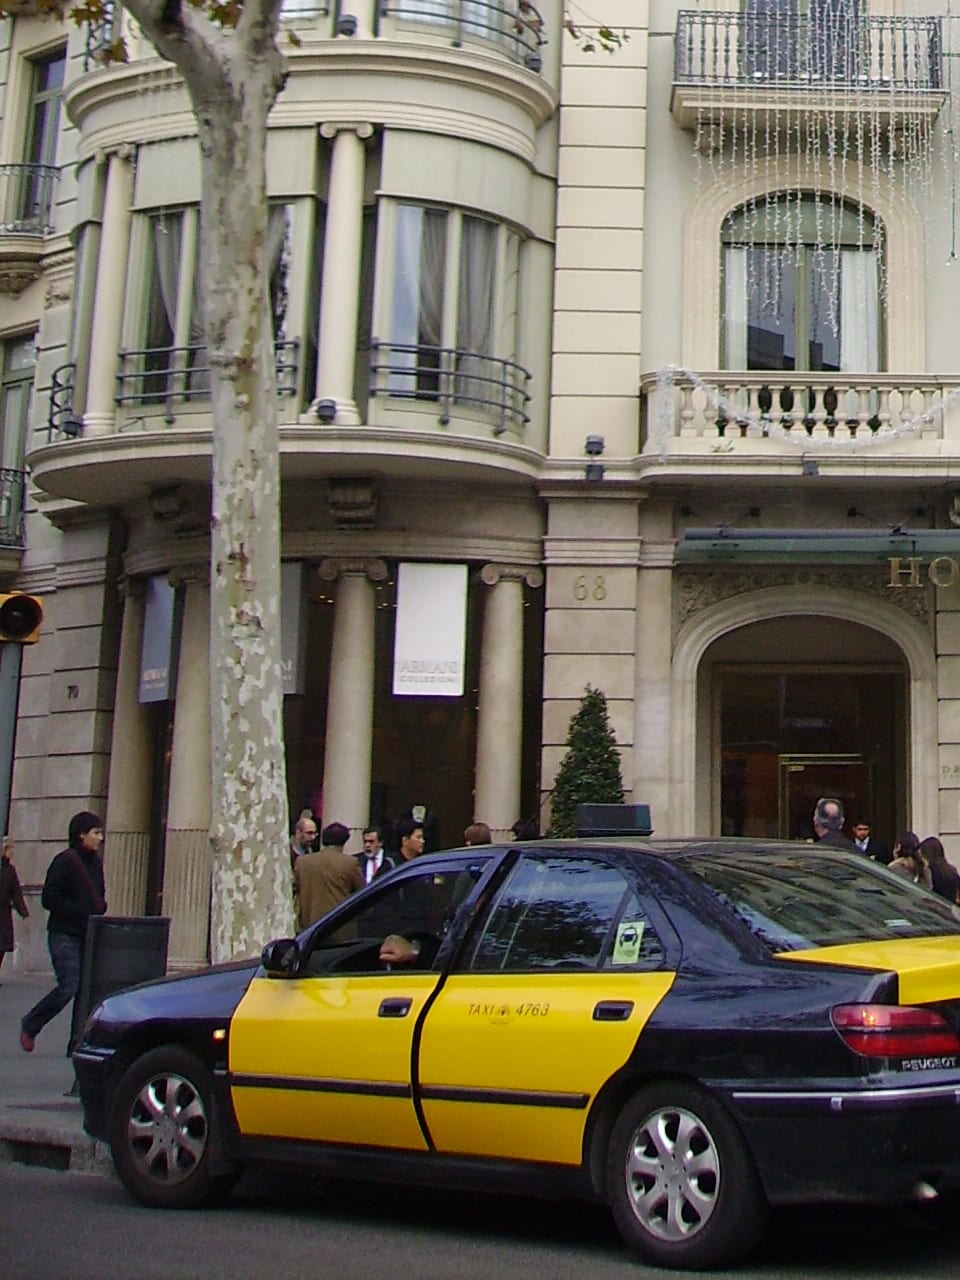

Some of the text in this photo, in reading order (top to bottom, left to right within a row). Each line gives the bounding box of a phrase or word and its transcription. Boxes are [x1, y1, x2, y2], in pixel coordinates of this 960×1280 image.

[573, 574, 607, 601] 68
[468, 1003, 494, 1016] TAXI
[901, 1056, 957, 1071] PEUGEOT
